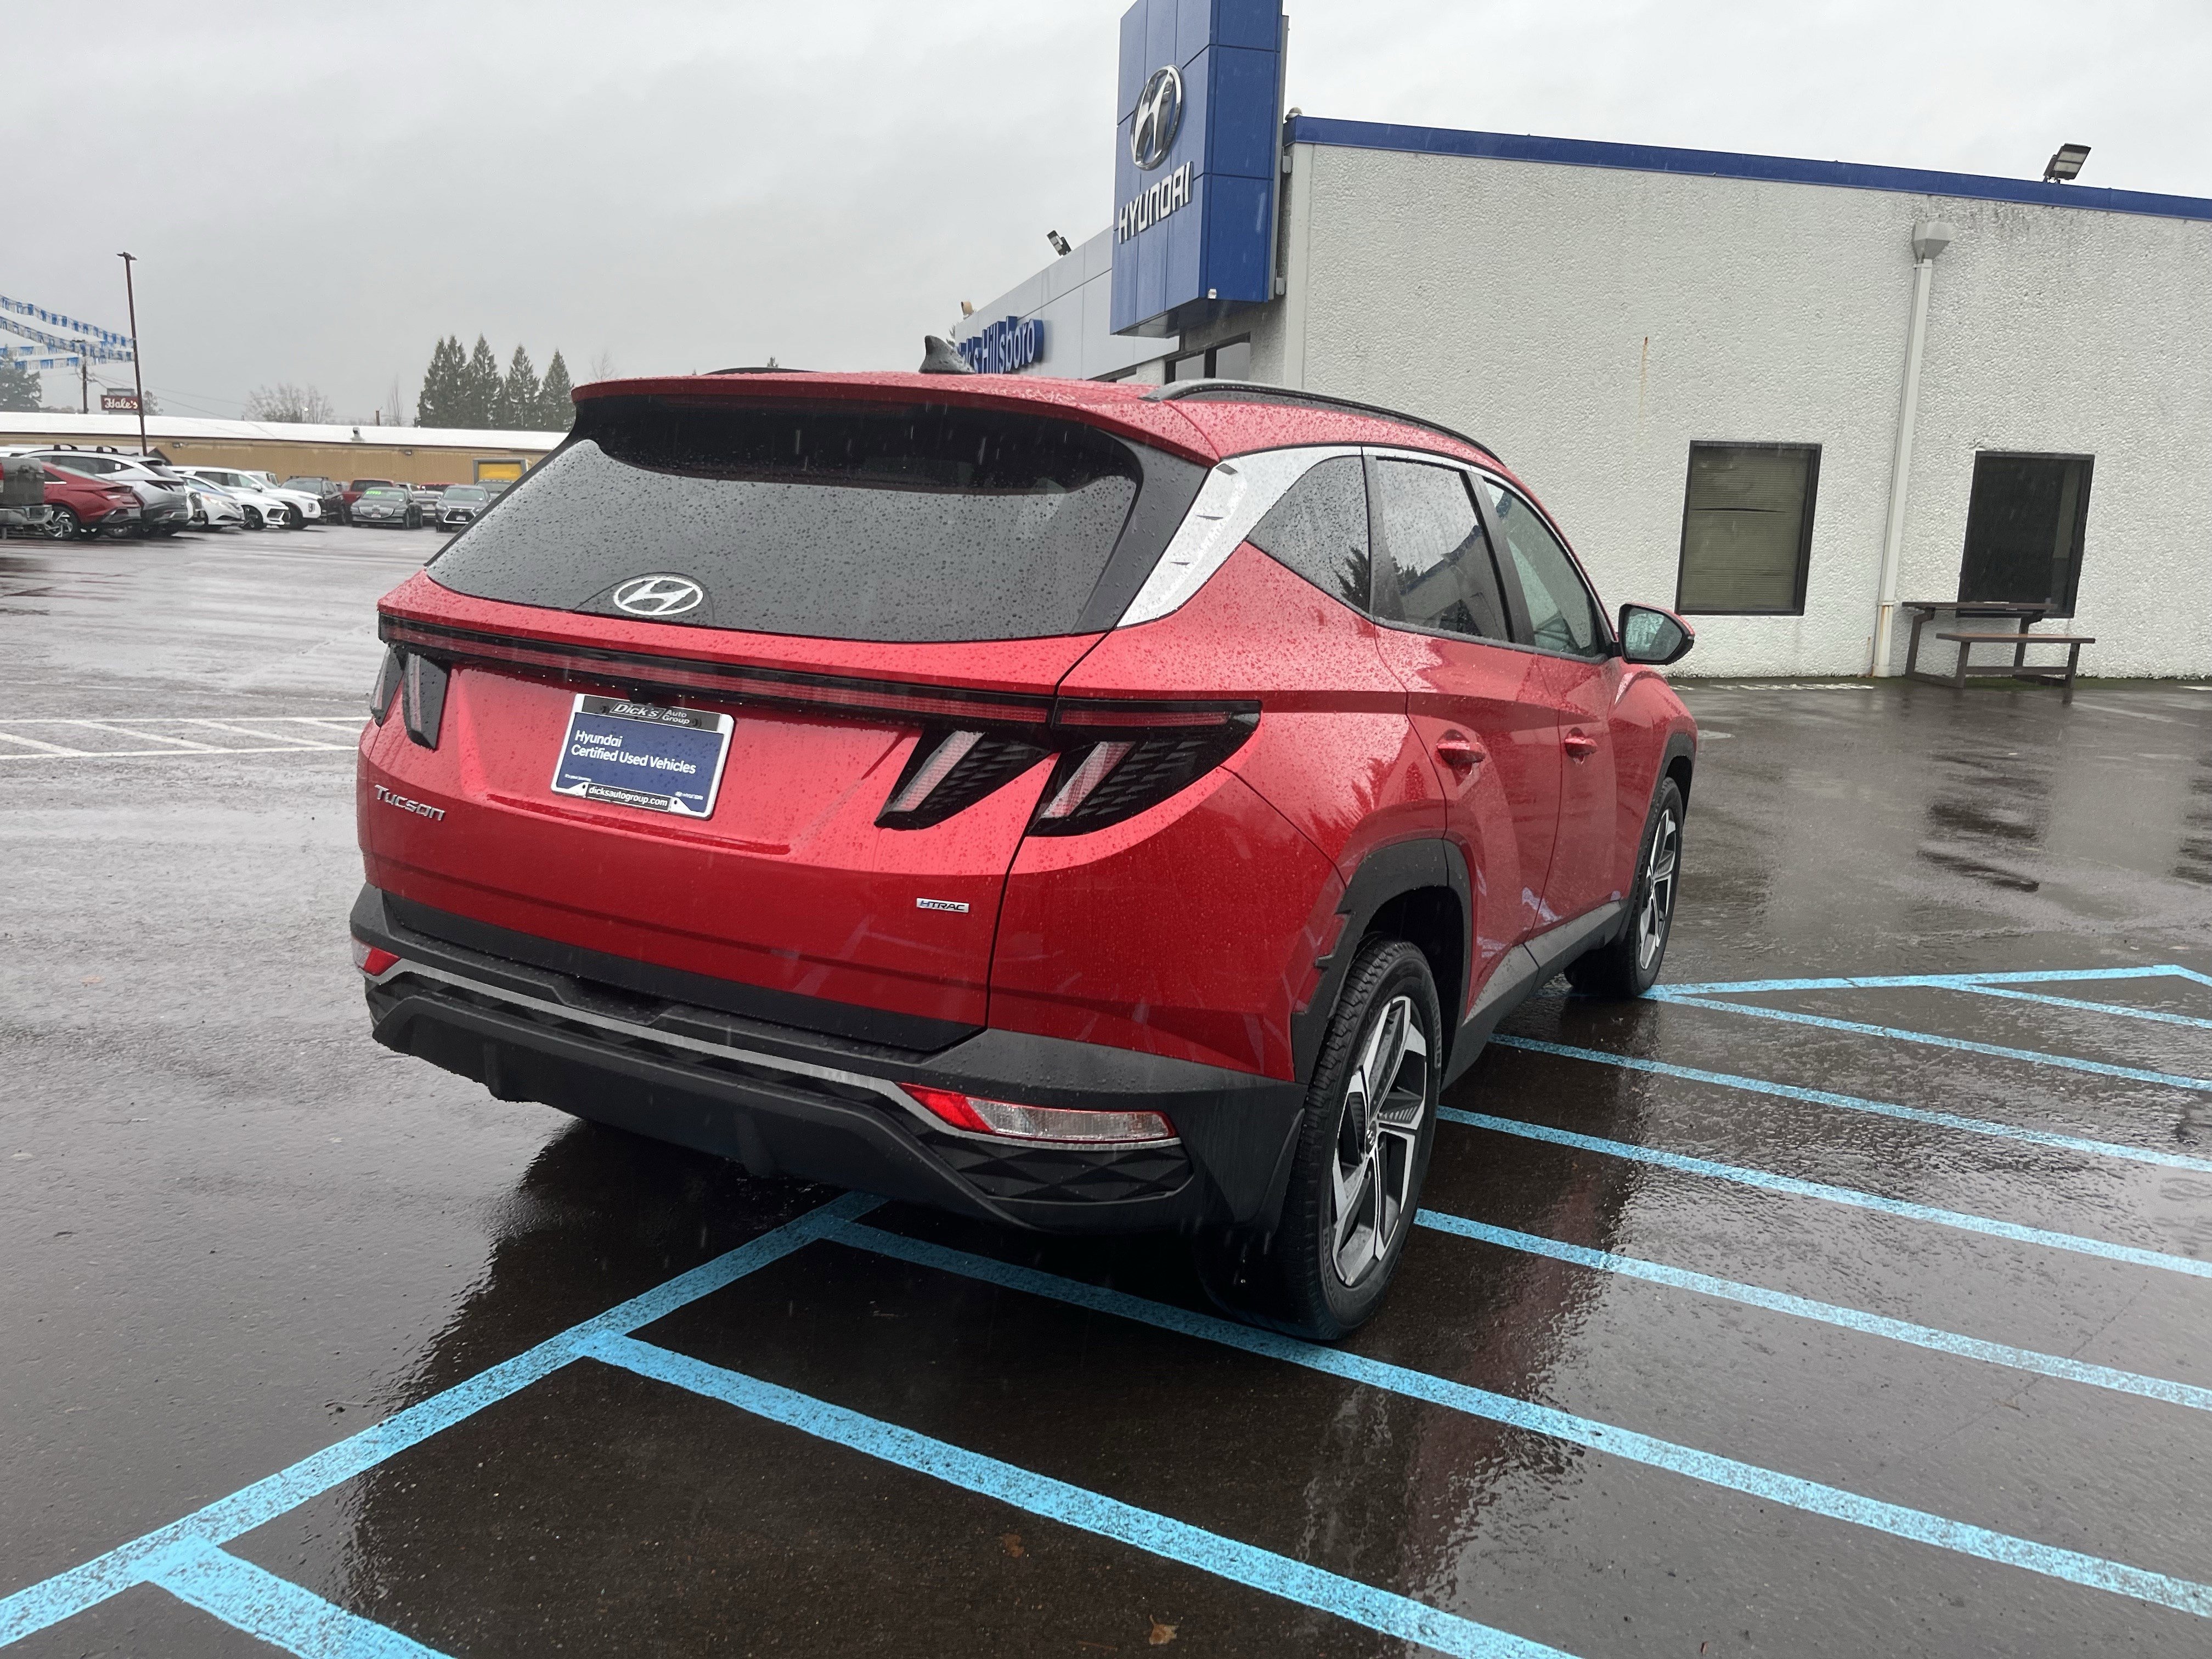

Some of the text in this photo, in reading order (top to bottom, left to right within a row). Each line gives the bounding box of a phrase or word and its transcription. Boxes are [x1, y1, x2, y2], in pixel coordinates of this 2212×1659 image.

[1119, 161, 1193, 244] HYUNDAI
[981, 315, 1038, 375] Hillsboro
[104, 398, 138, 409] Hale's
[613, 703, 687, 718] Dick's Auto
[662, 715, 691, 725] Group
[574, 730, 623, 747] Hyundai
[571, 744, 697, 774] Certified Used Vehicles
[588, 786, 668, 806] dicksautogroup.com
[920, 900, 965, 911] HTRAC
